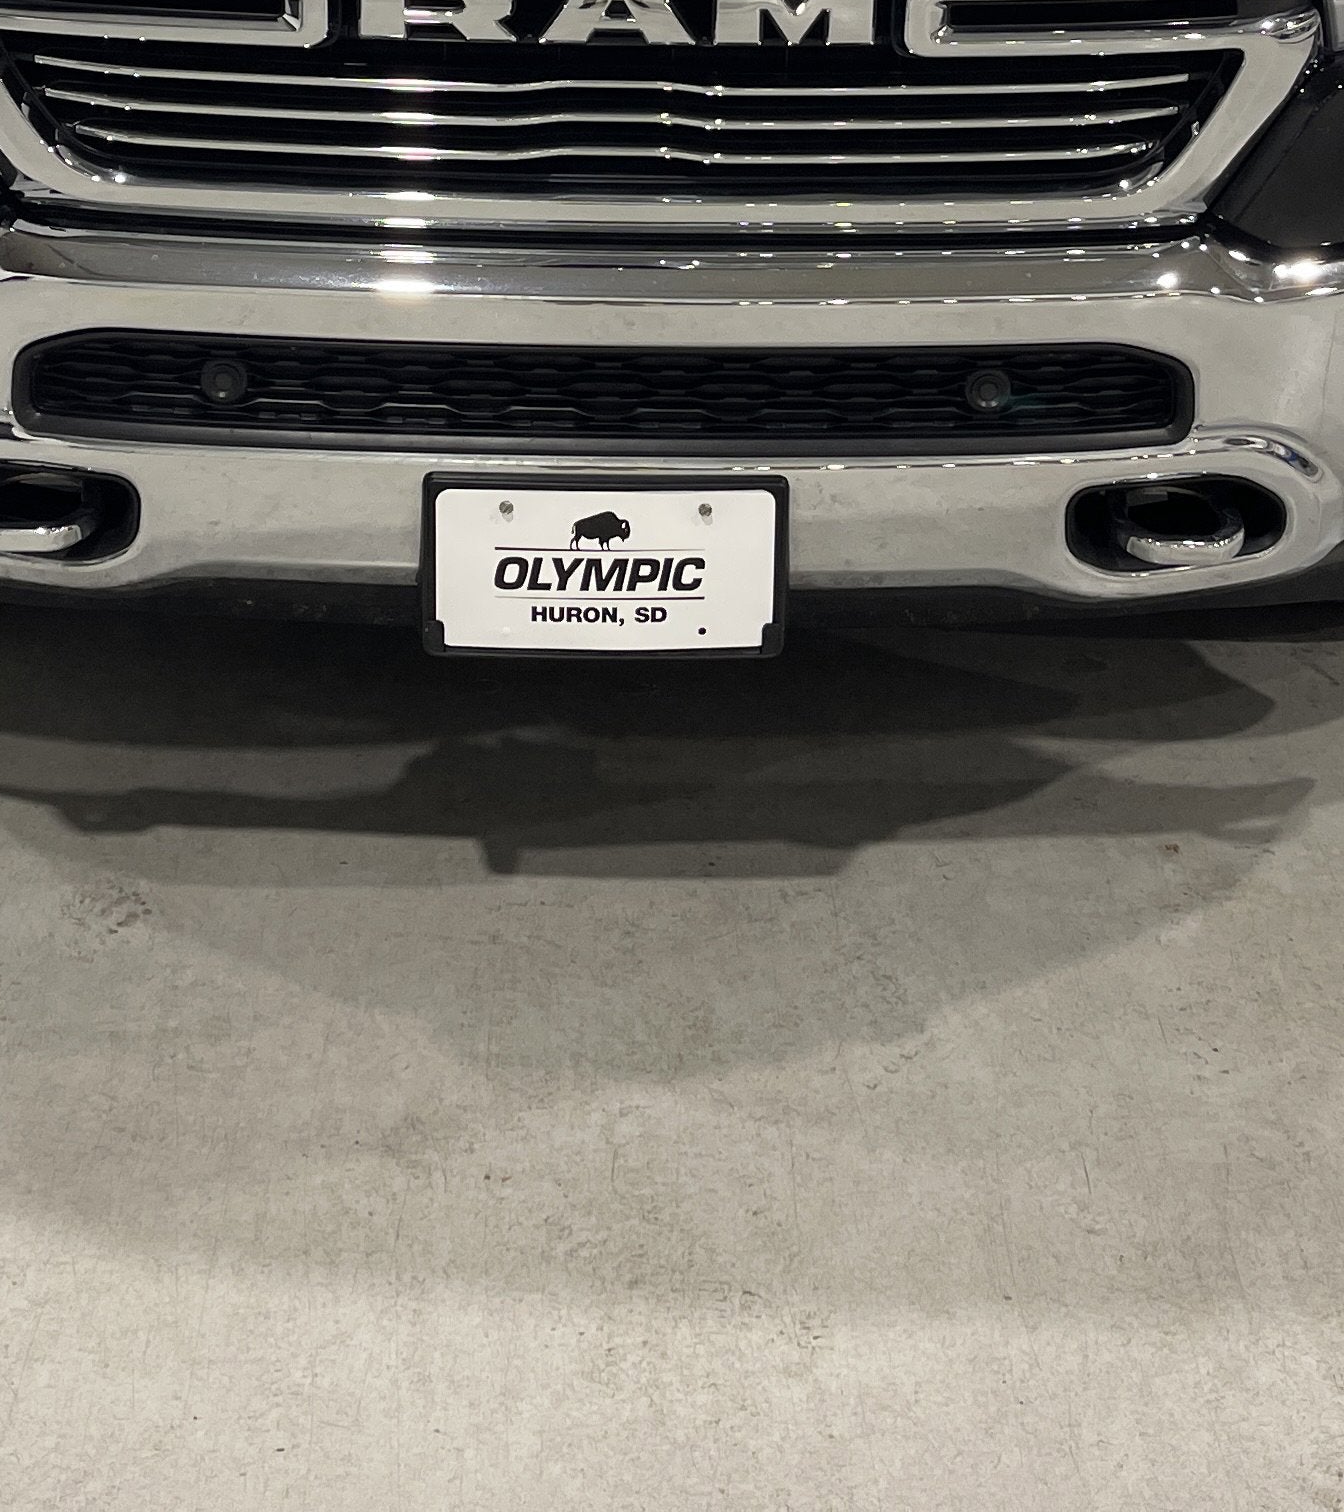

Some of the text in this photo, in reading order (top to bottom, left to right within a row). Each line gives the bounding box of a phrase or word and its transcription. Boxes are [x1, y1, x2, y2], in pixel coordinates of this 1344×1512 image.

[494, 556, 706, 592] OLYMPIC
[531, 605, 667, 627] HURON, SD
